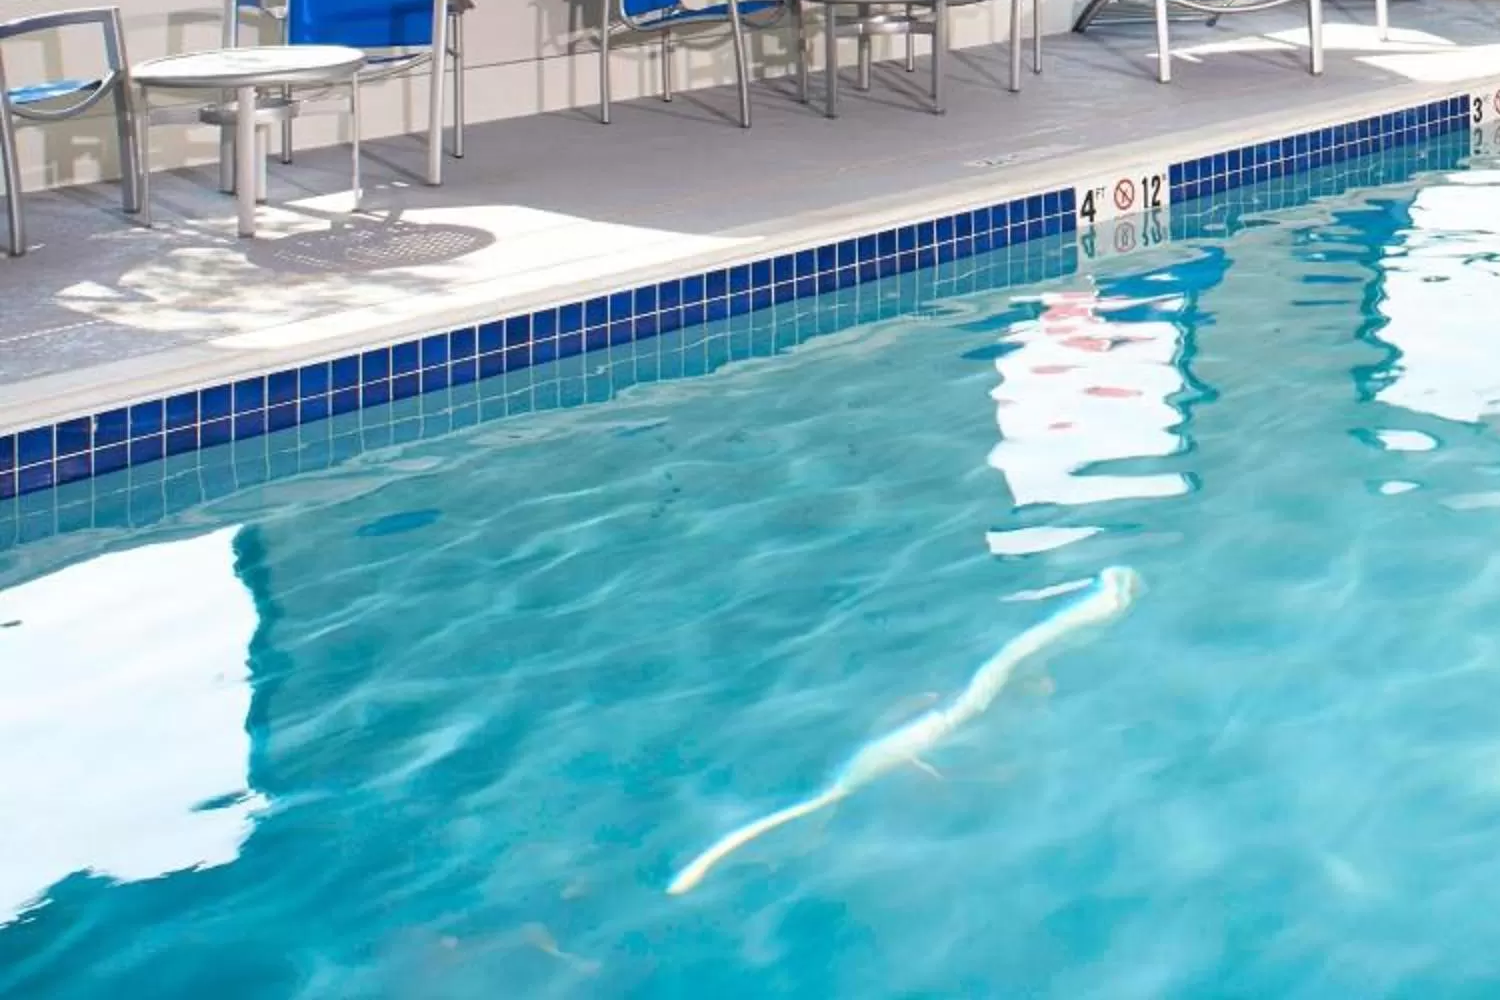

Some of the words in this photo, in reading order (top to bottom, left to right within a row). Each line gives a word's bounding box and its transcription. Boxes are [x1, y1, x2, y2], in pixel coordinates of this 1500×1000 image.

[1473, 96, 1483, 123] 3
[1080, 189, 1096, 222] 4
[1141, 175, 1161, 208] 12
